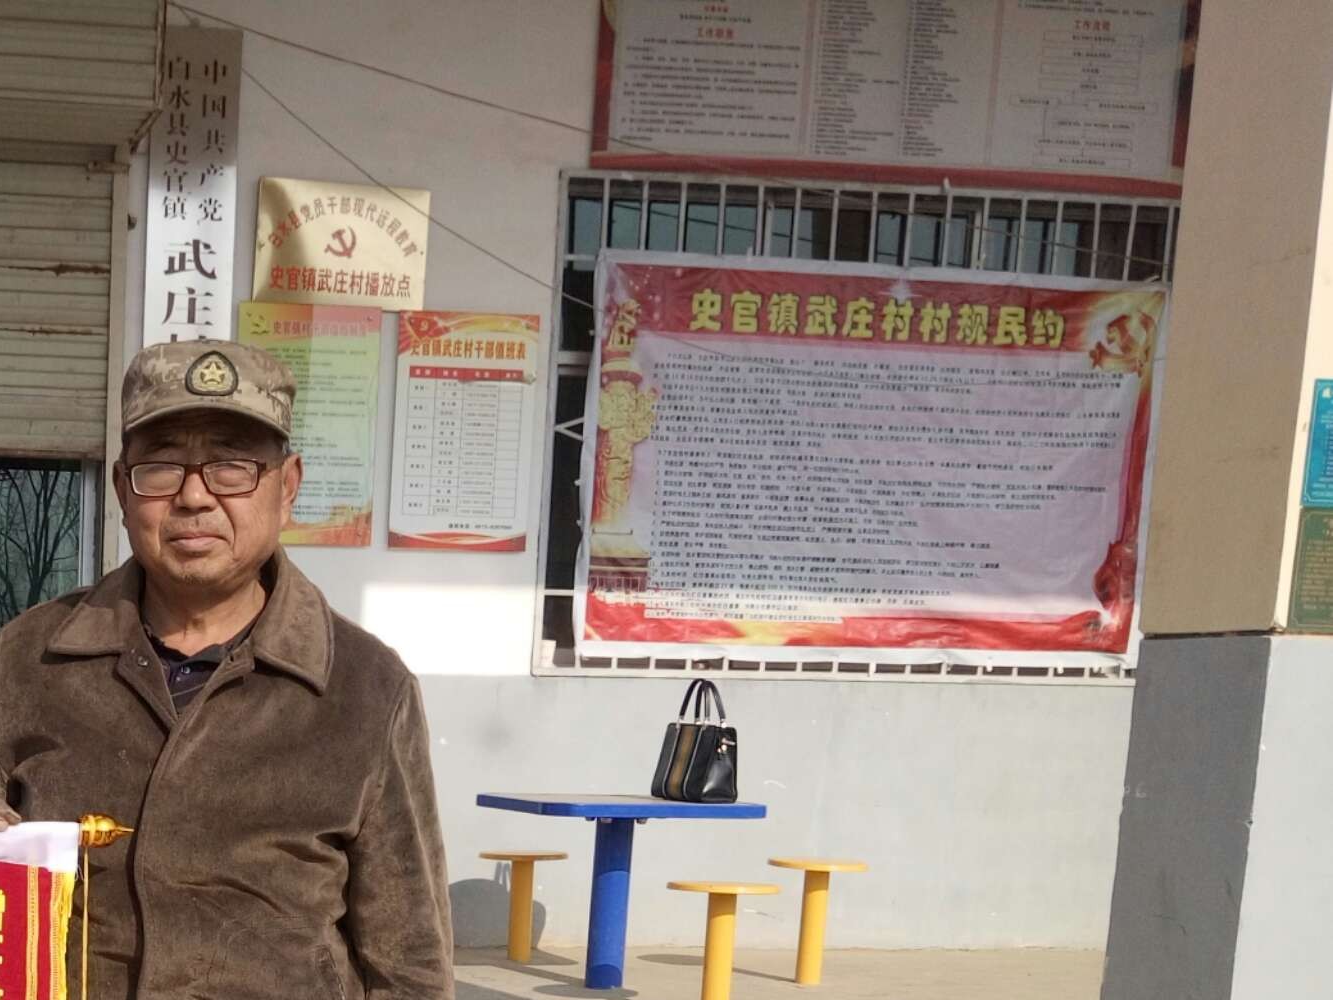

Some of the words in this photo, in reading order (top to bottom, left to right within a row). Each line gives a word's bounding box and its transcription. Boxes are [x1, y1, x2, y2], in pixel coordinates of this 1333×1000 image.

[163, 56, 191, 221] 白水县史官镇
[199, 59, 229, 222] 中国共产党
[161, 239, 218, 342] 武庄
[270, 266, 412, 298] 史官镇武庄村播放点
[689, 288, 1066, 348] 史官镇武庄村村规民约
